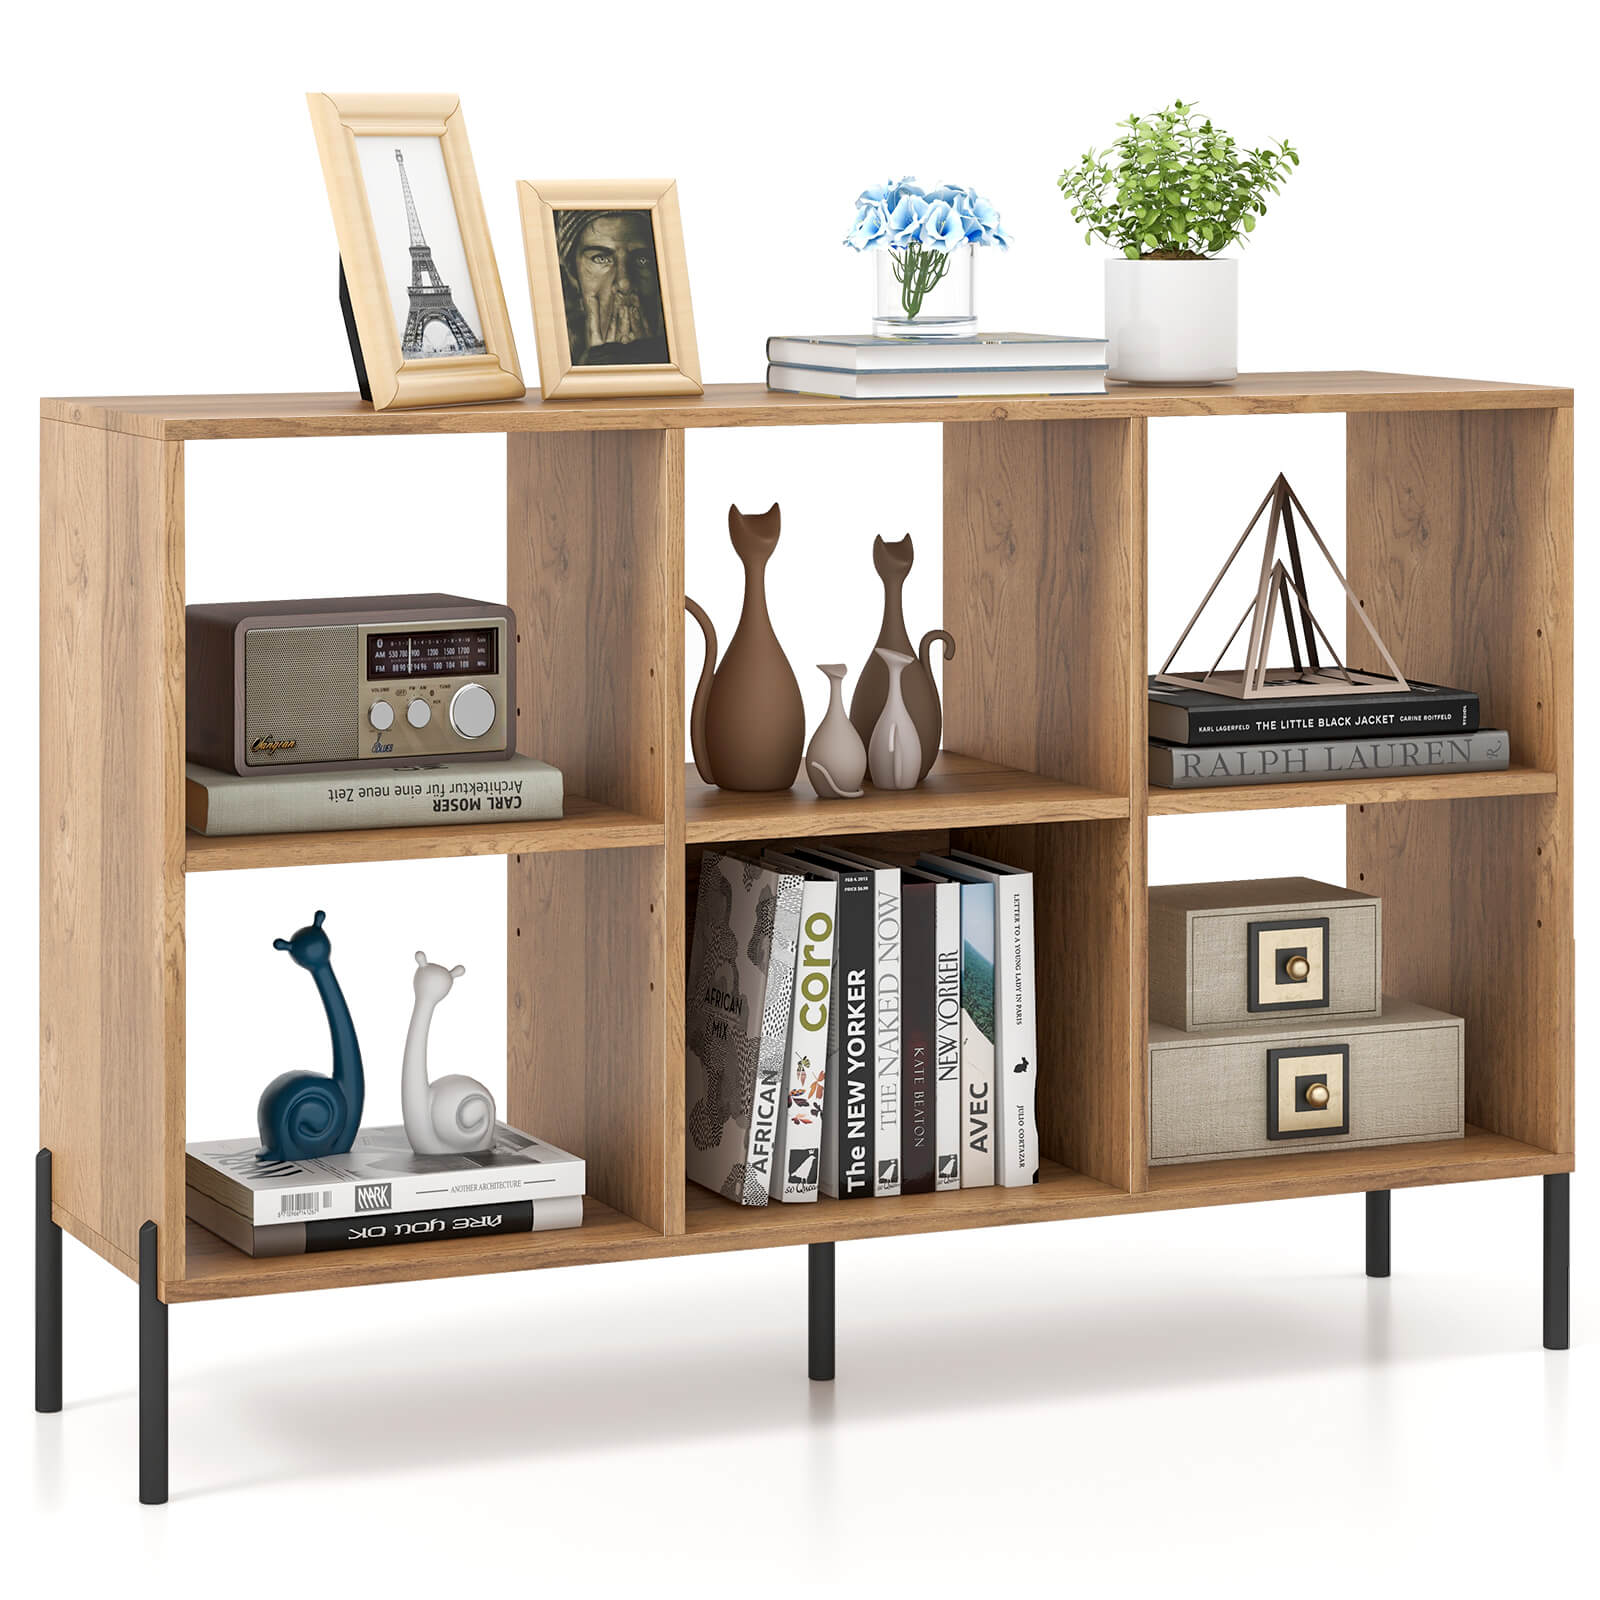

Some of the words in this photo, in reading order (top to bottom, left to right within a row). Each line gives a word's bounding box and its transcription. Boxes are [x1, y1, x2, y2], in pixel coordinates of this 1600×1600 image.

[443, 647, 455, 655] 1500
[457, 646, 470, 655] 1700
[1215, 724, 1251, 732] LAGERFELD
[1256, 720, 1277, 731] THE
[1280, 718, 1315, 730] LITTLE
[1318, 716, 1351, 728] BLACK
[1354, 714, 1395, 725] JACKET
[1399, 714, 1422, 722] CARINE
[1423, 713, 1452, 721] ROITFELD
[1180, 748, 1309, 779] RALPH
[1323, 738, 1473, 772] LAUREN
[328, 788, 354, 803] Zeit
[358, 787, 390, 798] neue
[394, 784, 422, 799] eine
[426, 783, 445, 798] für
[449, 780, 523, 796] Architektur
[433, 798, 481, 812] MOSER
[487, 795, 522, 810] CARL
[878, 890, 900, 963] NOW
[1014, 924, 1021, 936] TO
[799, 912, 833, 1032] coro
[704, 987, 743, 1016] AFRICAN
[937, 950, 959, 1032] YORKER
[1015, 993, 1022, 1003] IN
[711, 1020, 729, 1040] MIX
[846, 968, 866, 1075] YORKER
[878, 973, 900, 1079] NAKED
[913, 1047, 925, 1085] KATE
[938, 1034, 959, 1081] NEW
[847, 1080, 866, 1139] NEW
[880, 1083, 897, 1131] THE
[913, 1091, 926, 1148] BEATON
[969, 1082, 988, 1154] AVEC
[1016, 1105, 1025, 1127] JULIO
[752, 1069, 778, 1174] AFRICAN
[1018, 1127, 1026, 1169] CORTAZAR
[846, 1145, 866, 1193] The
[357, 1184, 390, 1209] MARK
[450, 1184, 481, 1193] ANOTHER
[480, 1180, 522, 1191] ARCHITECTURE
[347, 1226, 386, 1240] OK
